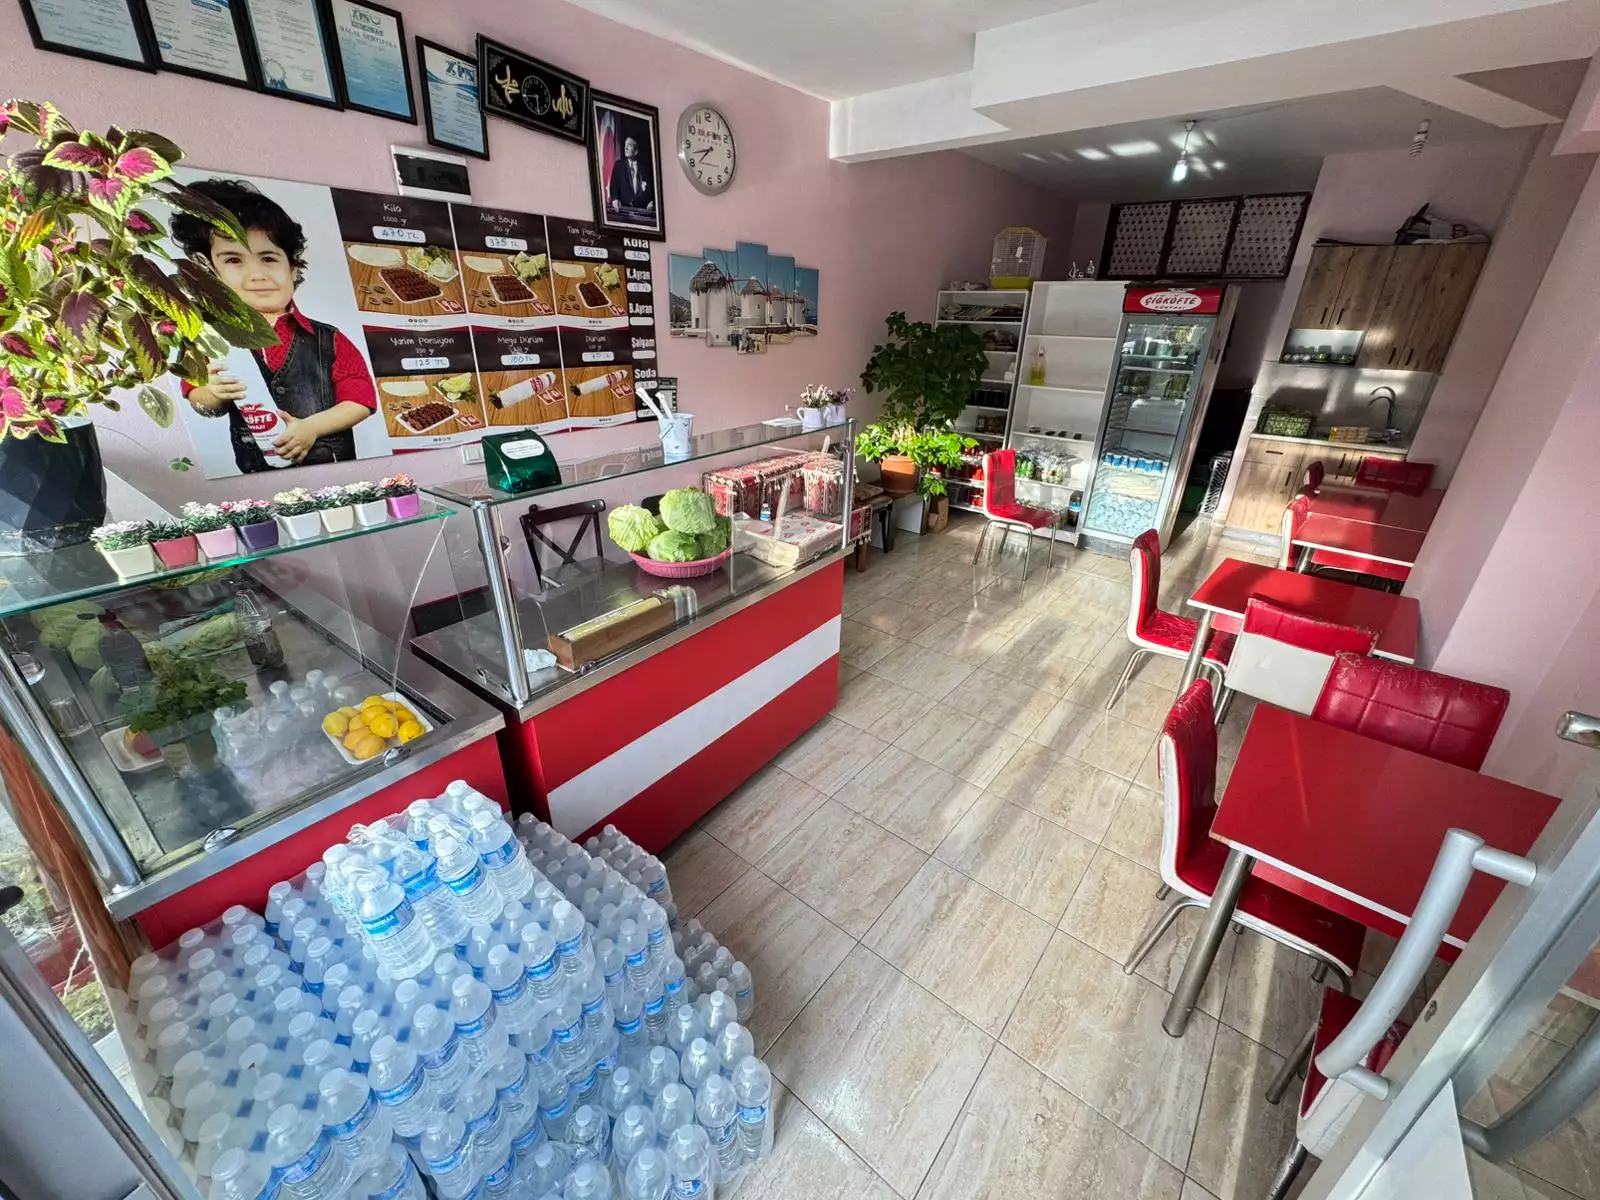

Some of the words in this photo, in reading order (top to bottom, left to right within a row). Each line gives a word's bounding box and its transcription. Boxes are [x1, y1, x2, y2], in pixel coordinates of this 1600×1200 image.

[695, 113, 702, 125] 11
[704, 112, 712, 123] 12
[688, 125, 696, 135] 10
[685, 139, 692, 149] 9
[722, 134, 729, 144] 2
[726, 149, 732, 159] 3
[688, 158, 696, 168] 8
[697, 170, 703, 180] 7
[723, 166, 729, 175] 4
[706, 176, 713, 186] 6
[716, 174, 723, 184] 5
[383, 202, 402, 213] Kilo
[498, 214, 518, 228] Boyu
[568, 225, 580, 235] Tam
[407, 231, 420, 240] TL
[623, 237, 649, 249] Kola
[626, 267, 651, 281] K.Ayran
[628, 302, 653, 315] B.Ayran
[418, 336, 455, 348] Porsiyon
[497, 336, 517, 347] Mega
[519, 335, 544, 344] Dürüm
[634, 368, 657, 379] Soda
